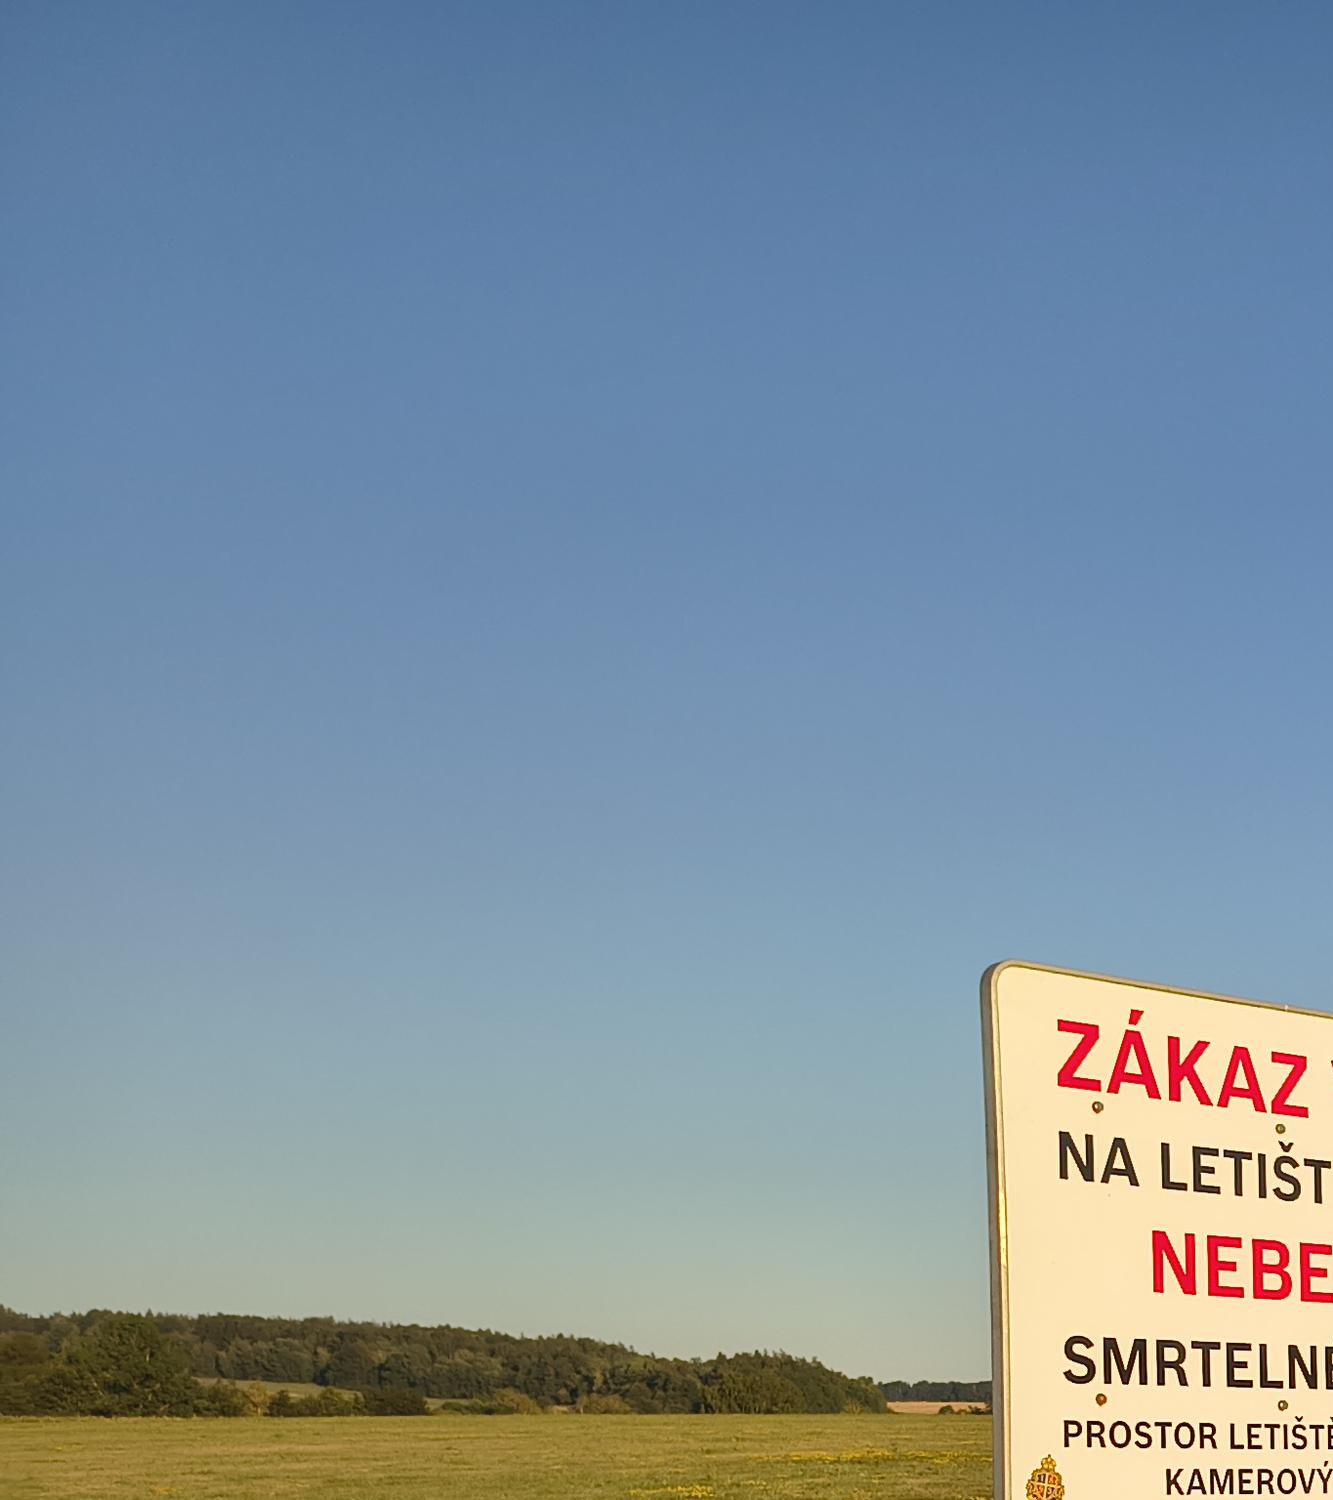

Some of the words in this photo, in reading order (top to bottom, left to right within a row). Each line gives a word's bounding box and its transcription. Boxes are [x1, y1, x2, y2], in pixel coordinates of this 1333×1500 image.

[1056, 1009, 1310, 1119] ZÁKAZ
[1058, 1131, 1140, 1188] NA
[1063, 1419, 1218, 1450] PROSTOR
